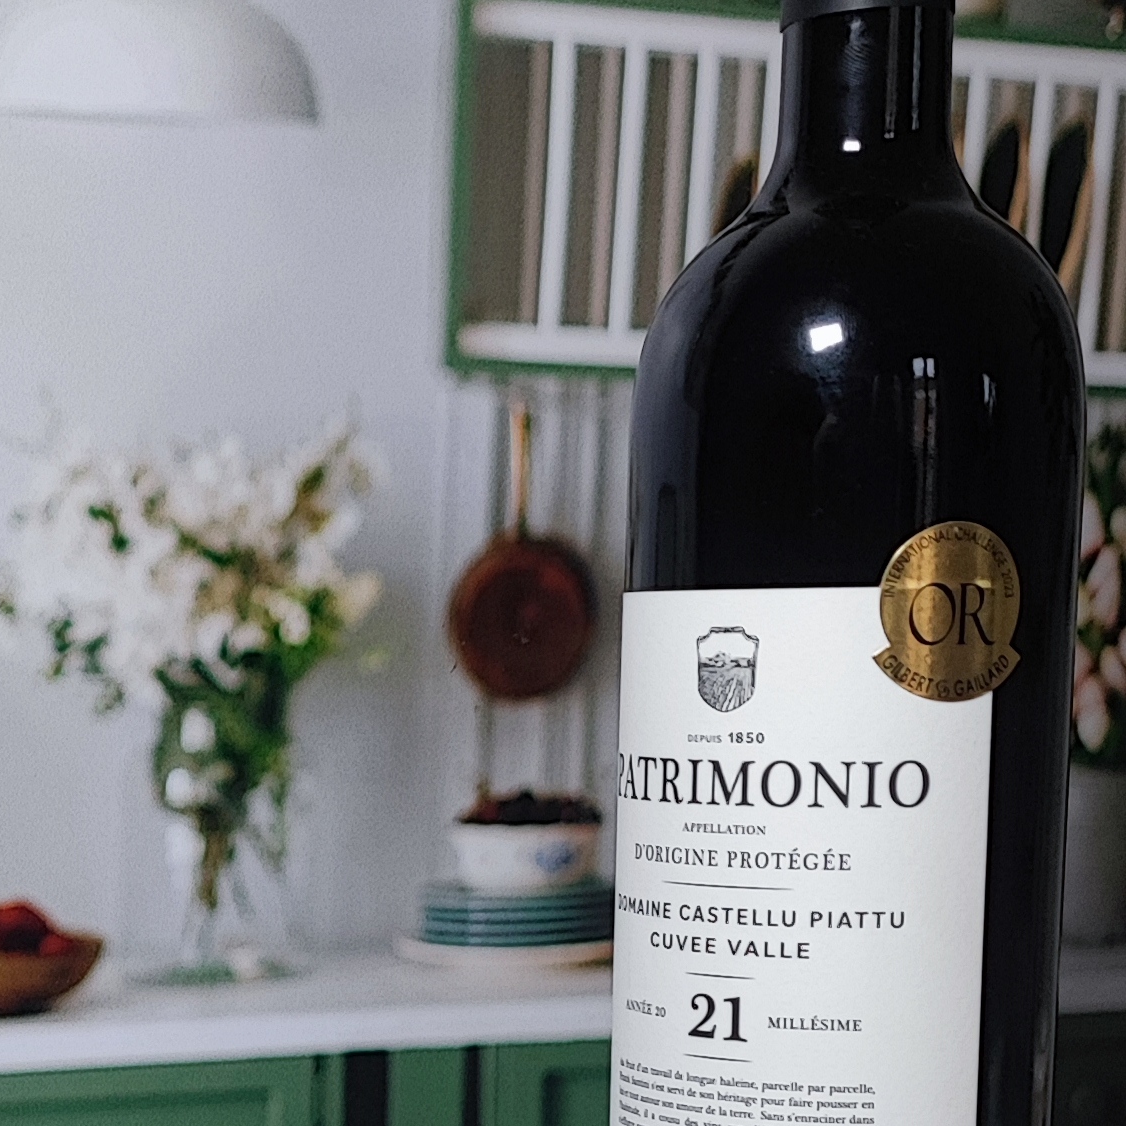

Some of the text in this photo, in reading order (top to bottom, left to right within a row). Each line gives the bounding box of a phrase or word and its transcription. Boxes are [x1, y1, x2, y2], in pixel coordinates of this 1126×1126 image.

[884, 529, 952, 598] INTERNATIONAL
[954, 526, 1007, 568] CHALLENGE
[909, 582, 996, 646] OR
[882, 654, 934, 694] GILBERT
[953, 654, 1009, 697] GAILLARD
[687, 732, 765, 744] DEPUIS 1850
[618, 753, 930, 808] PATRIMONIO
[682, 822, 766, 836] APPELLATION
[635, 842, 852, 871] D'ORIGINE PROTÉGÉE
[679, 904, 796, 928] CASTELLU
[810, 911, 905, 929] PIATTU
[650, 931, 811, 959] CUVEE VALLE
[655, 1005, 667, 1018] 20
[688, 993, 748, 1042] 21
[767, 1015, 863, 1032] MILLÉSIME
[687, 1087, 696, 1097] de
[699, 1092, 714, 1100] son
[717, 1091, 757, 1107] héritage
[761, 1097, 785, 1108] pour
[789, 1097, 813, 1108] faire
[817, 1100, 858, 1111] pousser
[720, 1076, 759, 1090] haleine,
[762, 1082, 804, 1093] parcelle
[808, 1085, 826, 1096] par
[829, 1084, 875, 1096] parcelle,
[705, 1105, 716, 1115] de
[719, 1106, 727, 1116] la
[760, 1111, 784, 1121] Sans
[787, 1112, 846, 1124] s'enraciner
[849, 1114, 875, 1124] dans
